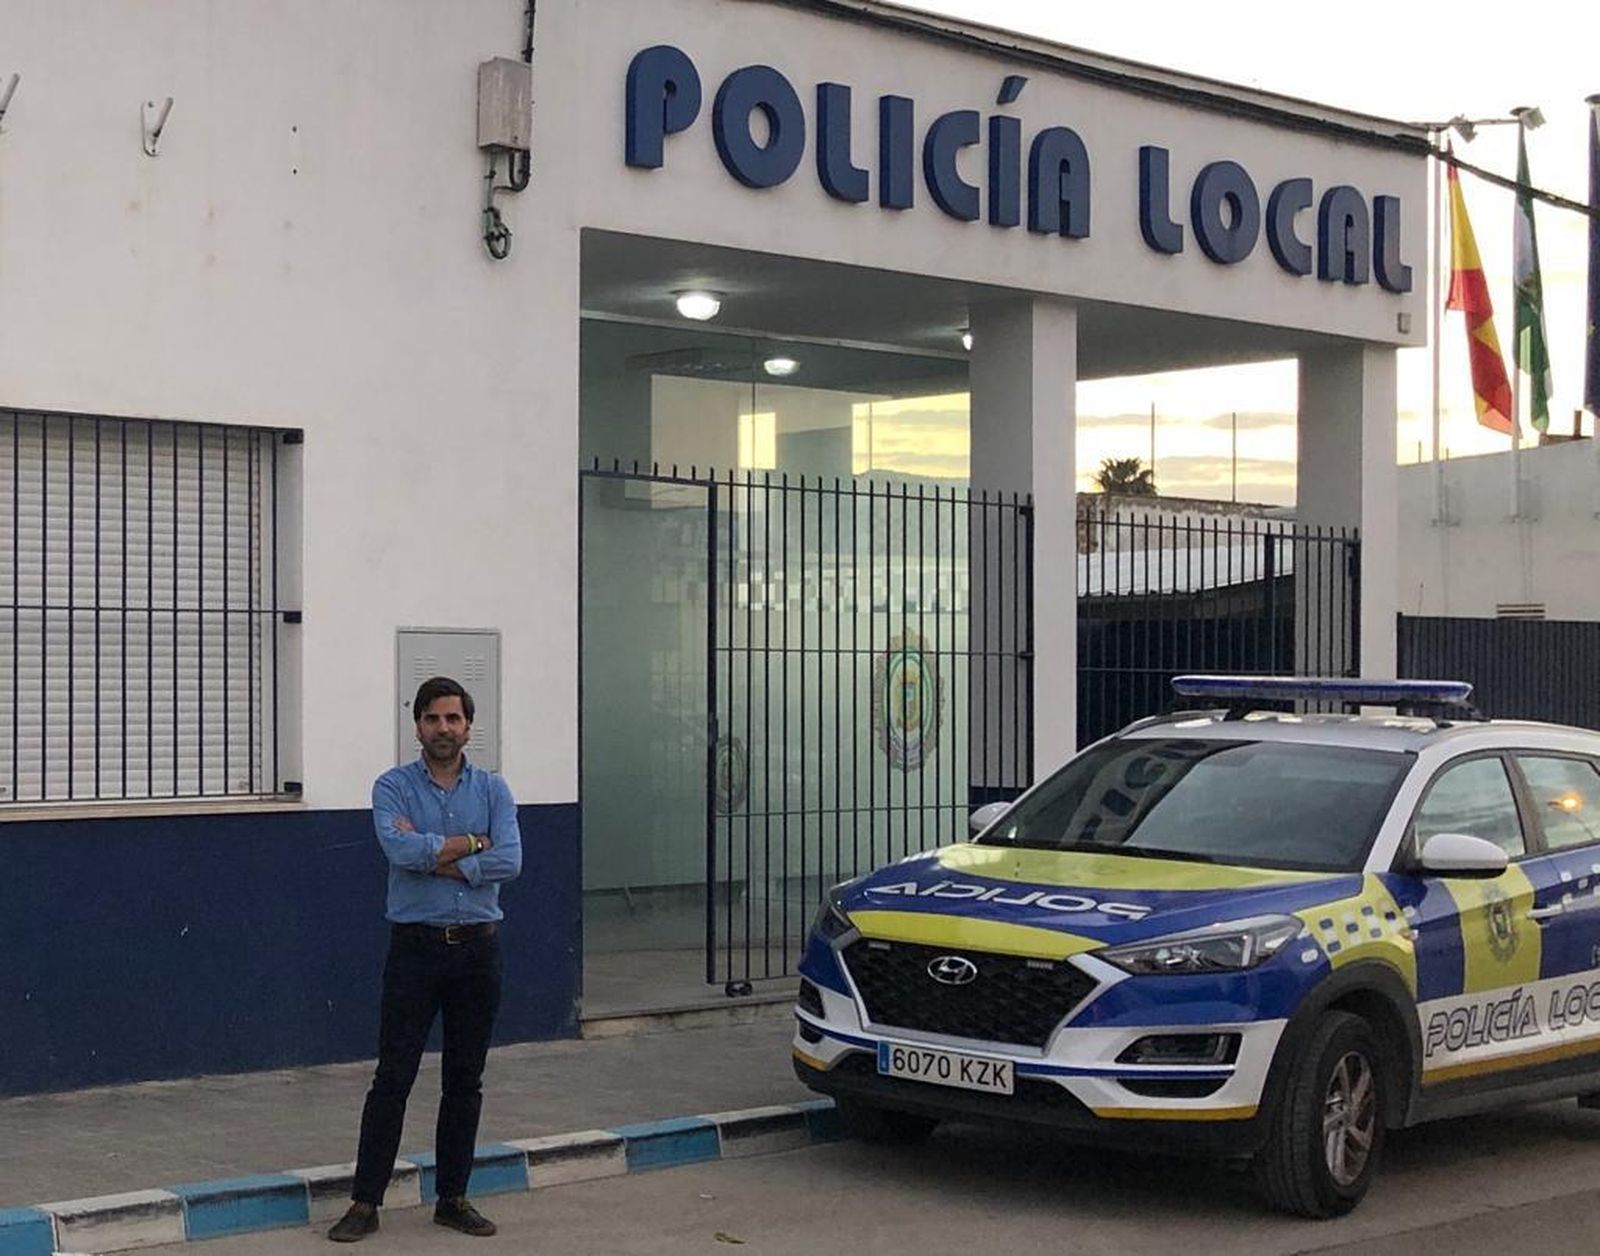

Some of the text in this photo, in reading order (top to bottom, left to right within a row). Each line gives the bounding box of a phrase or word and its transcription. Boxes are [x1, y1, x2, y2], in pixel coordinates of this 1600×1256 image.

[625, 45, 1412, 293] POLICÍA LOCAL
[1426, 988, 1541, 1057] POLICÍA
[893, 1048, 1007, 1088] 6070 KZK
